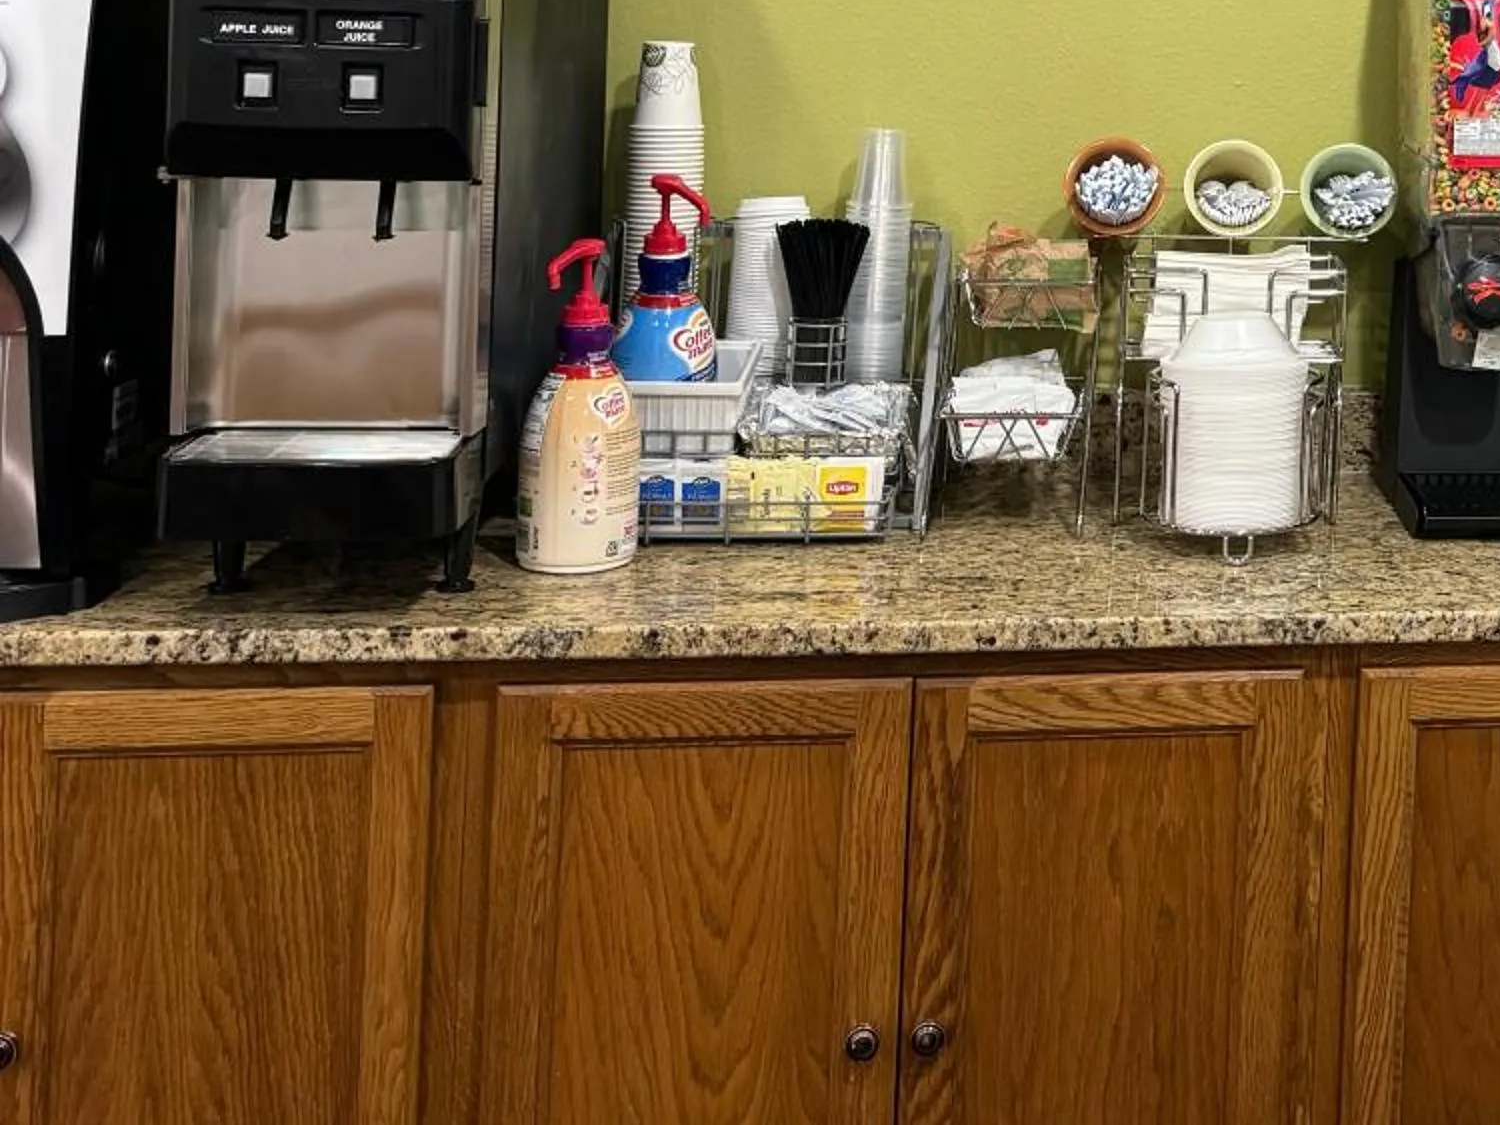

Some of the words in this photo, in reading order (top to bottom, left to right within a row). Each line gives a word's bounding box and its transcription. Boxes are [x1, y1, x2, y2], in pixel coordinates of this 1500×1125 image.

[220, 24, 257, 34] APPLE
[261, 24, 295, 35] JUICE
[336, 20, 383, 31] ORANGE
[343, 32, 377, 43] JUICE
